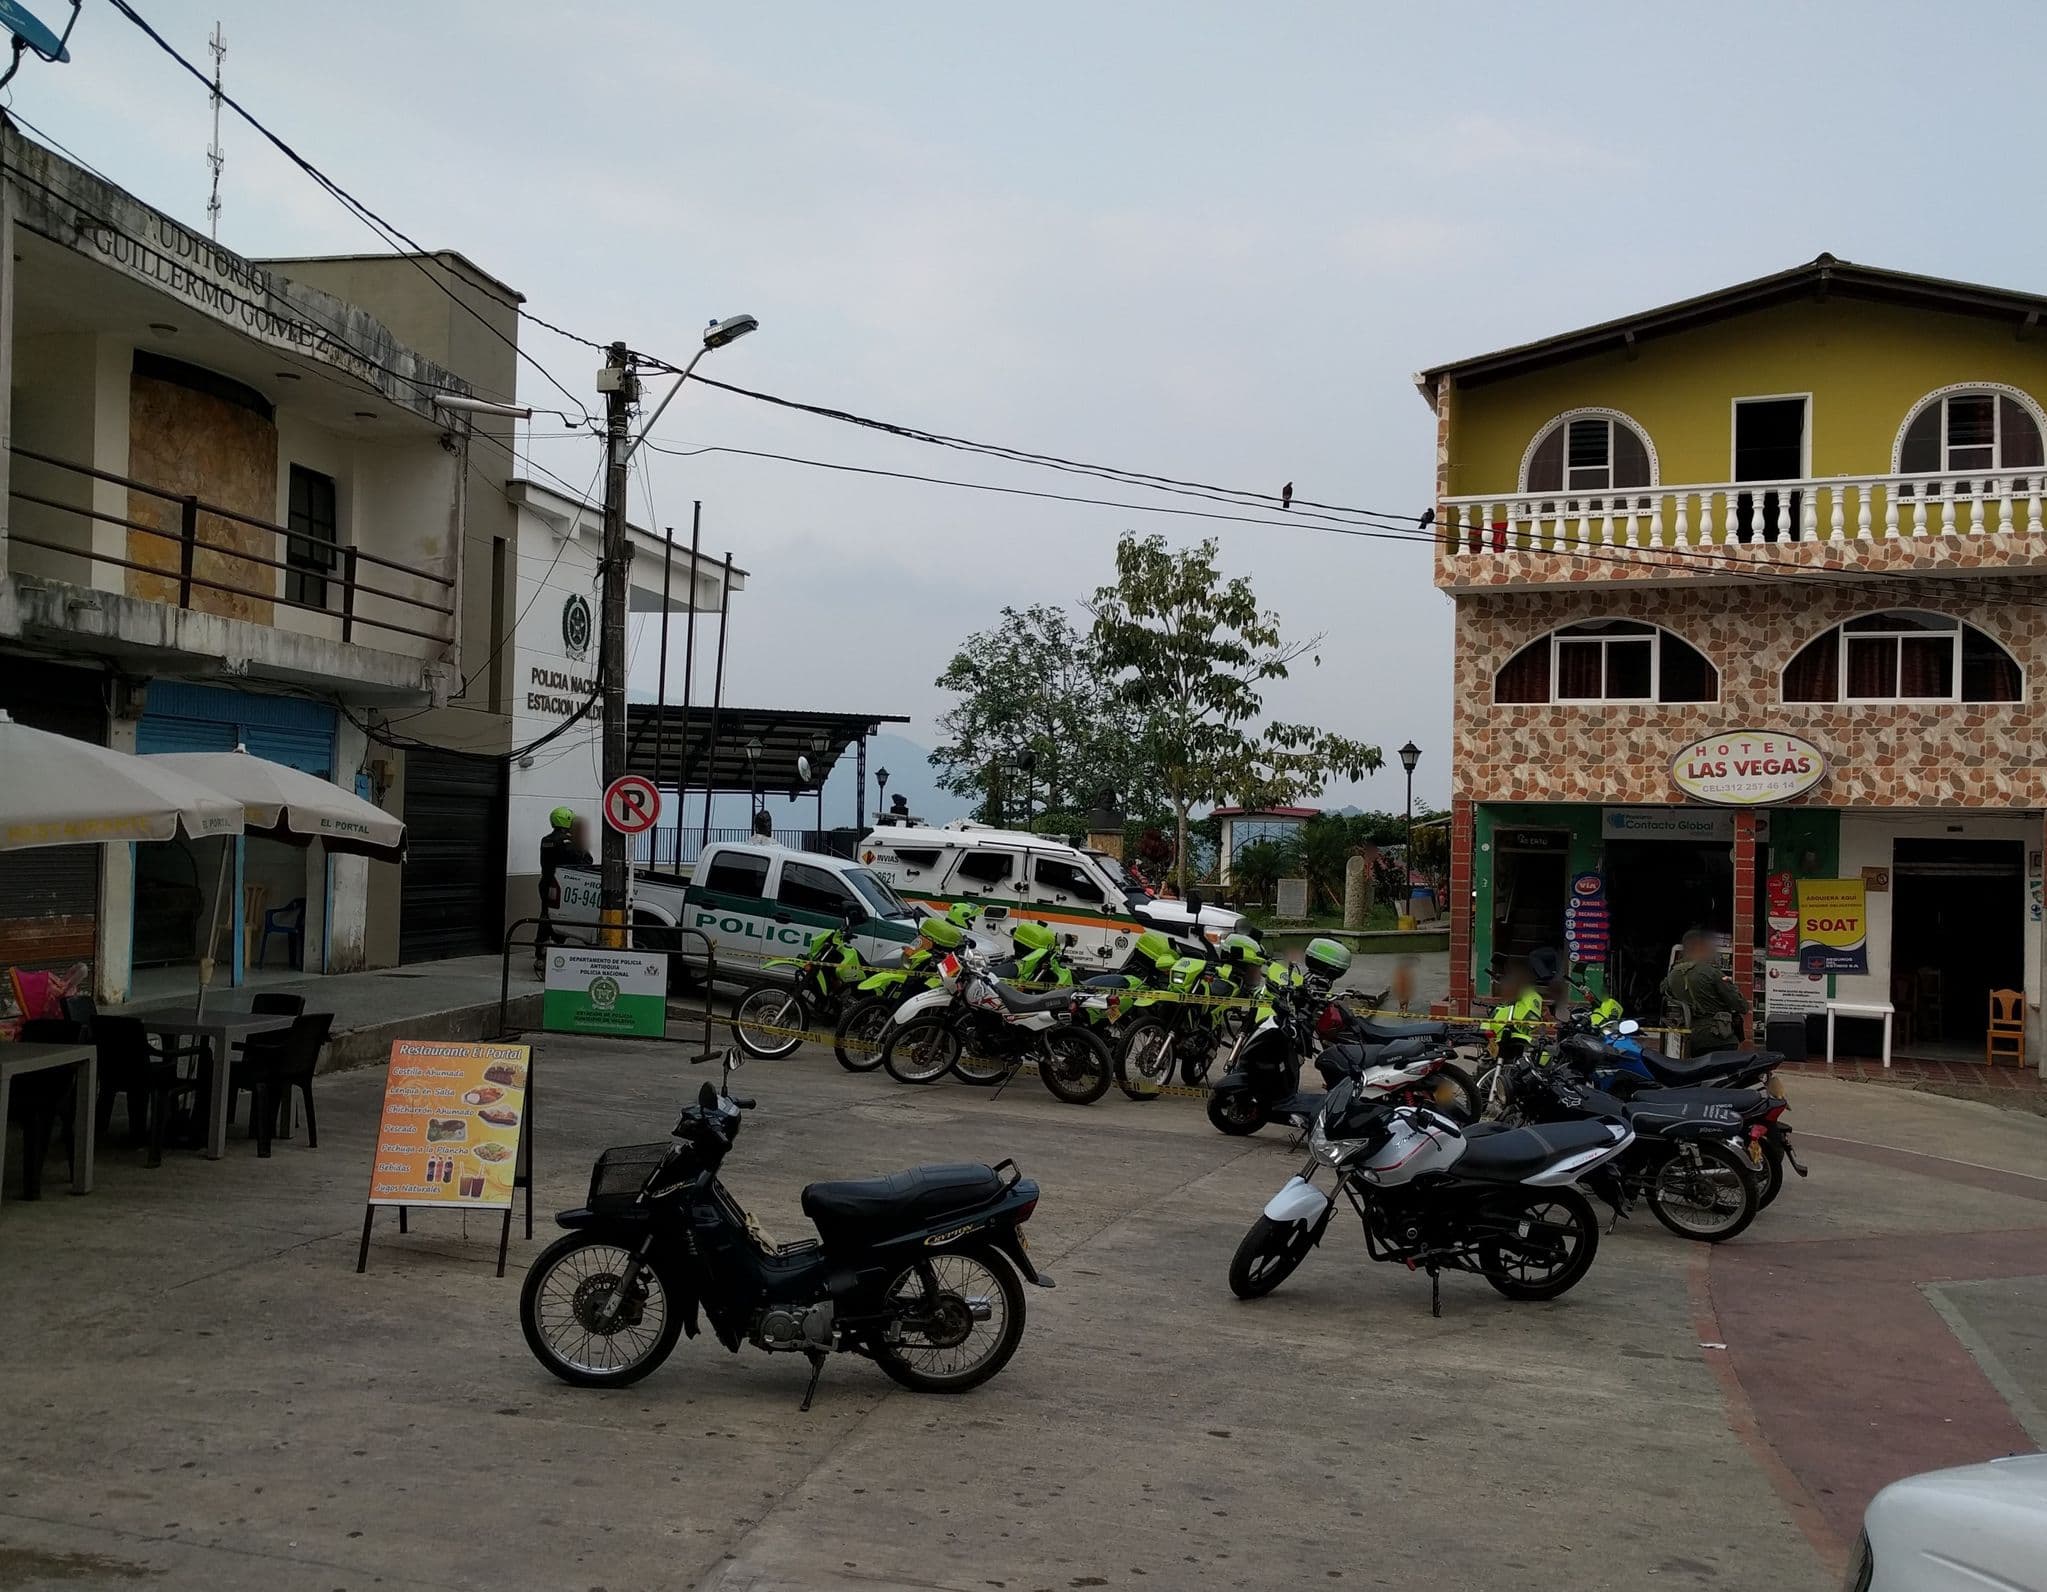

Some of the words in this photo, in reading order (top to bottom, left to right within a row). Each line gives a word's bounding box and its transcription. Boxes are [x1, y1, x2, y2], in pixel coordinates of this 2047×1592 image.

[93, 228, 236, 316] GUILLERMO
[241, 299, 332, 355] GOMEZ
[531, 667, 569, 691] POLICIA
[527, 692, 574, 716] ESTACION
[1695, 741, 1797, 757] HOTEL
[1687, 761, 1728, 779] LAS
[1733, 757, 1811, 777] VEGAS
[320, 818, 333, 828] EL
[334, 820, 370, 834] PORTAL
[1625, 819, 1676, 831] Contacto
[1678, 819, 1714, 832] Global
[877, 854, 899, 863] INVIAS
[694, 913, 813, 947] POLICI
[1806, 918, 1858, 932] SOAT
[569, 956, 611, 965] DEPARTAMENTO
[399, 1044, 470, 1058] Restaurante
[471, 1047, 483, 1058] El
[486, 1047, 523, 1060] Portal
[393, 1066, 422, 1076] Costilla
[425, 1068, 465, 1078] Ahumada
[390, 1087, 420, 1097] Lengua
[434, 1088, 456, 1097] Salsa
[435, 1107, 475, 1116] Ahumado
[384, 1125, 417, 1134] Pescado
[381, 1144, 416, 1154] Pechuga
[425, 1145, 433, 1153] la
[436, 1145, 469, 1155] Plancha
[378, 1163, 411, 1173] Bebidas
[376, 1184, 399, 1194] Jugos
[401, 1184, 441, 1194] Naturales
